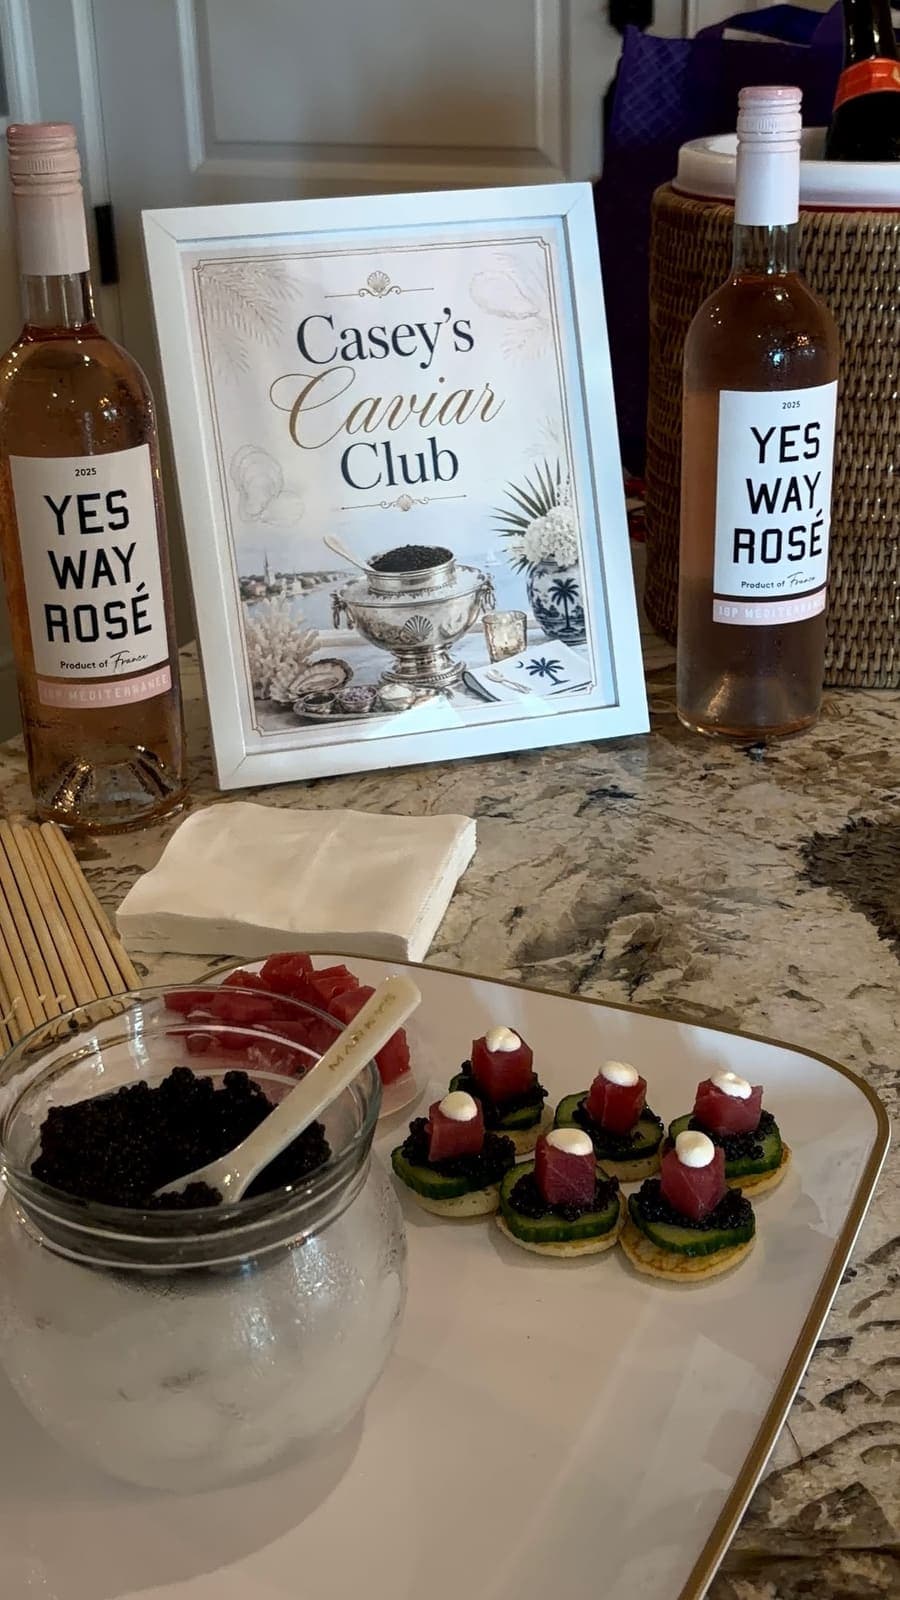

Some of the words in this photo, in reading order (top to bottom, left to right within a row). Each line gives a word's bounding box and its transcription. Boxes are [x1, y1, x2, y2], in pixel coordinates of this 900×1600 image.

[296, 307, 475, 369] Casey's
[269, 365, 505, 449] Caviar
[781, 401, 801, 409] 2025
[340, 436, 459, 490] Club
[750, 422, 820, 464] YES
[74, 467, 97, 477] 2025
[745, 471, 821, 514] WAY
[44, 489, 130, 535] YES
[732, 508, 824, 564] ROSÉ
[47, 542, 137, 590] WAY
[740, 580, 774, 589] Product
[776, 580, 785, 588] of
[786, 571, 816, 588] France
[44, 582, 152, 643] ROSÉ
[60, 660, 96, 670] Product
[98, 659, 108, 668] of
[110, 650, 148, 672] France
